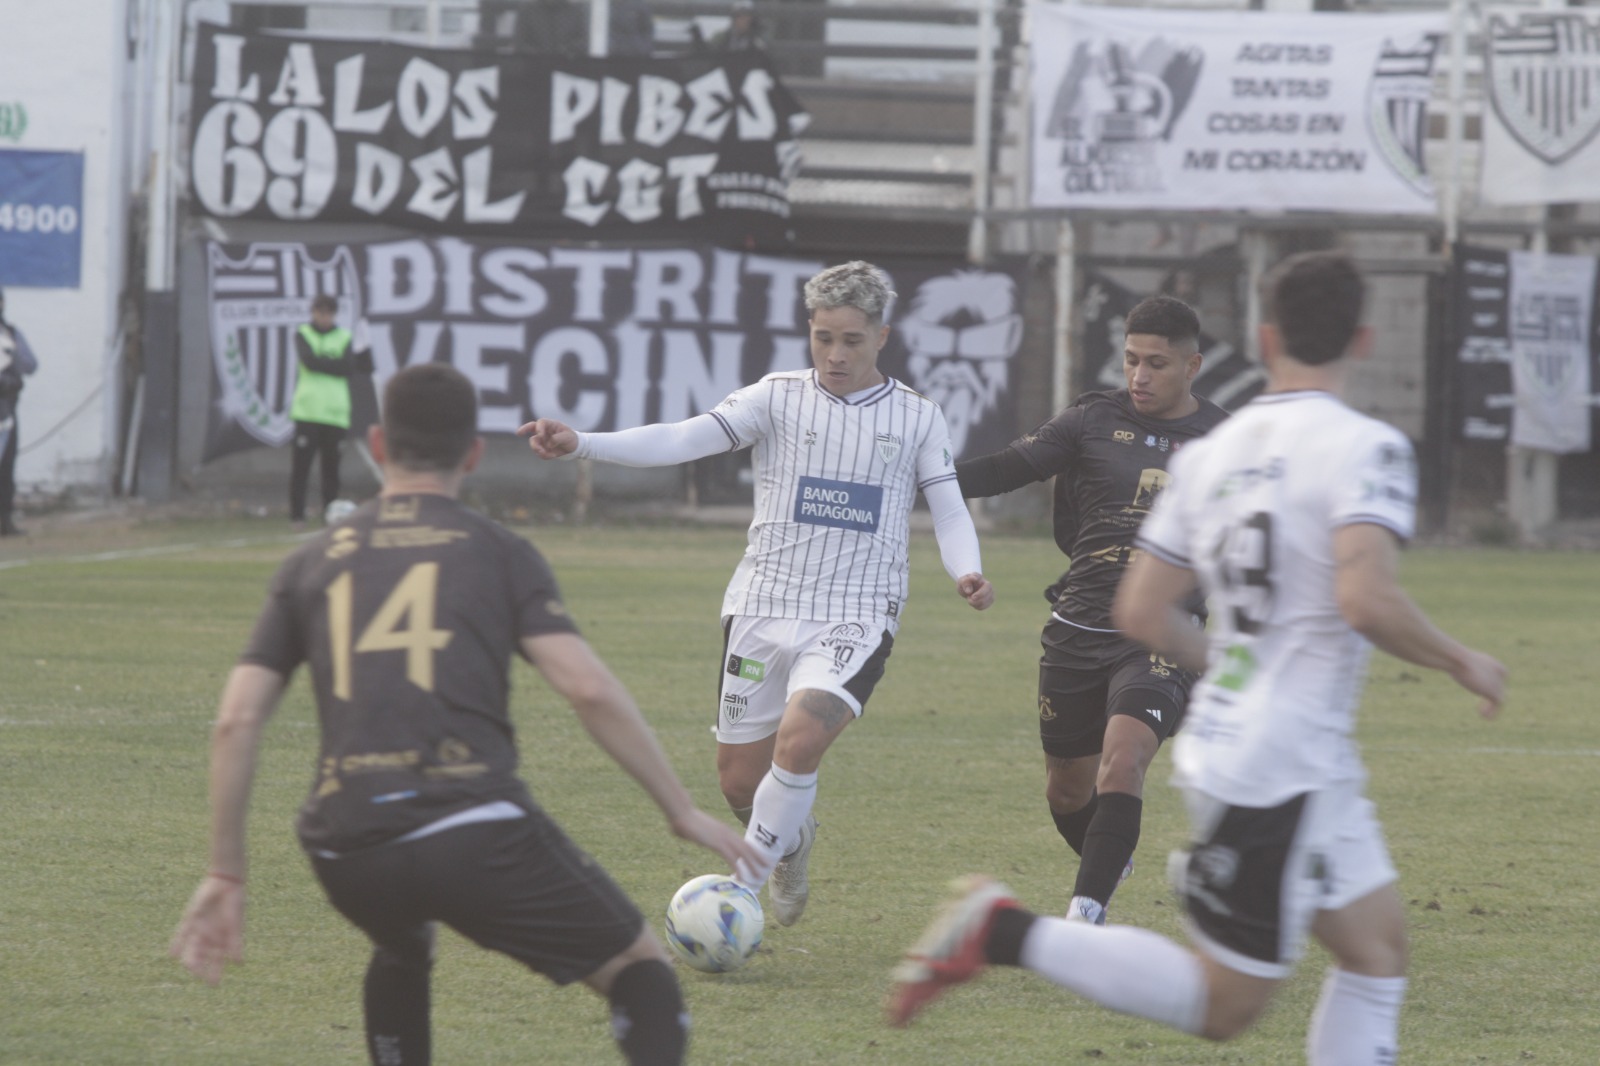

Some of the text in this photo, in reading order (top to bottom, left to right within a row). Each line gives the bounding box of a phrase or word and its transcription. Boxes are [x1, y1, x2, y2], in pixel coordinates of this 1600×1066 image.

[1235, 42, 1334, 64] AGITAS
[210, 34, 325, 106] LA
[333, 53, 778, 147] LOS PIBES
[1231, 77, 1332, 99] TANTAS
[1207, 112, 1345, 134] COSAS EN
[192, 100, 338, 220] 69
[1182, 144, 1367, 172] MI CORAZÓN
[351, 142, 719, 226] DEL CGT
[0, 203, 78, 233] 4900
[365, 237, 896, 329] DISTRIT
[803, 486, 849, 505] BANCO
[801, 503, 874, 525] PATAGONIA
[326, 561, 454, 700] 14
[833, 645, 855, 664] 10
[745, 664, 760, 676] RN
